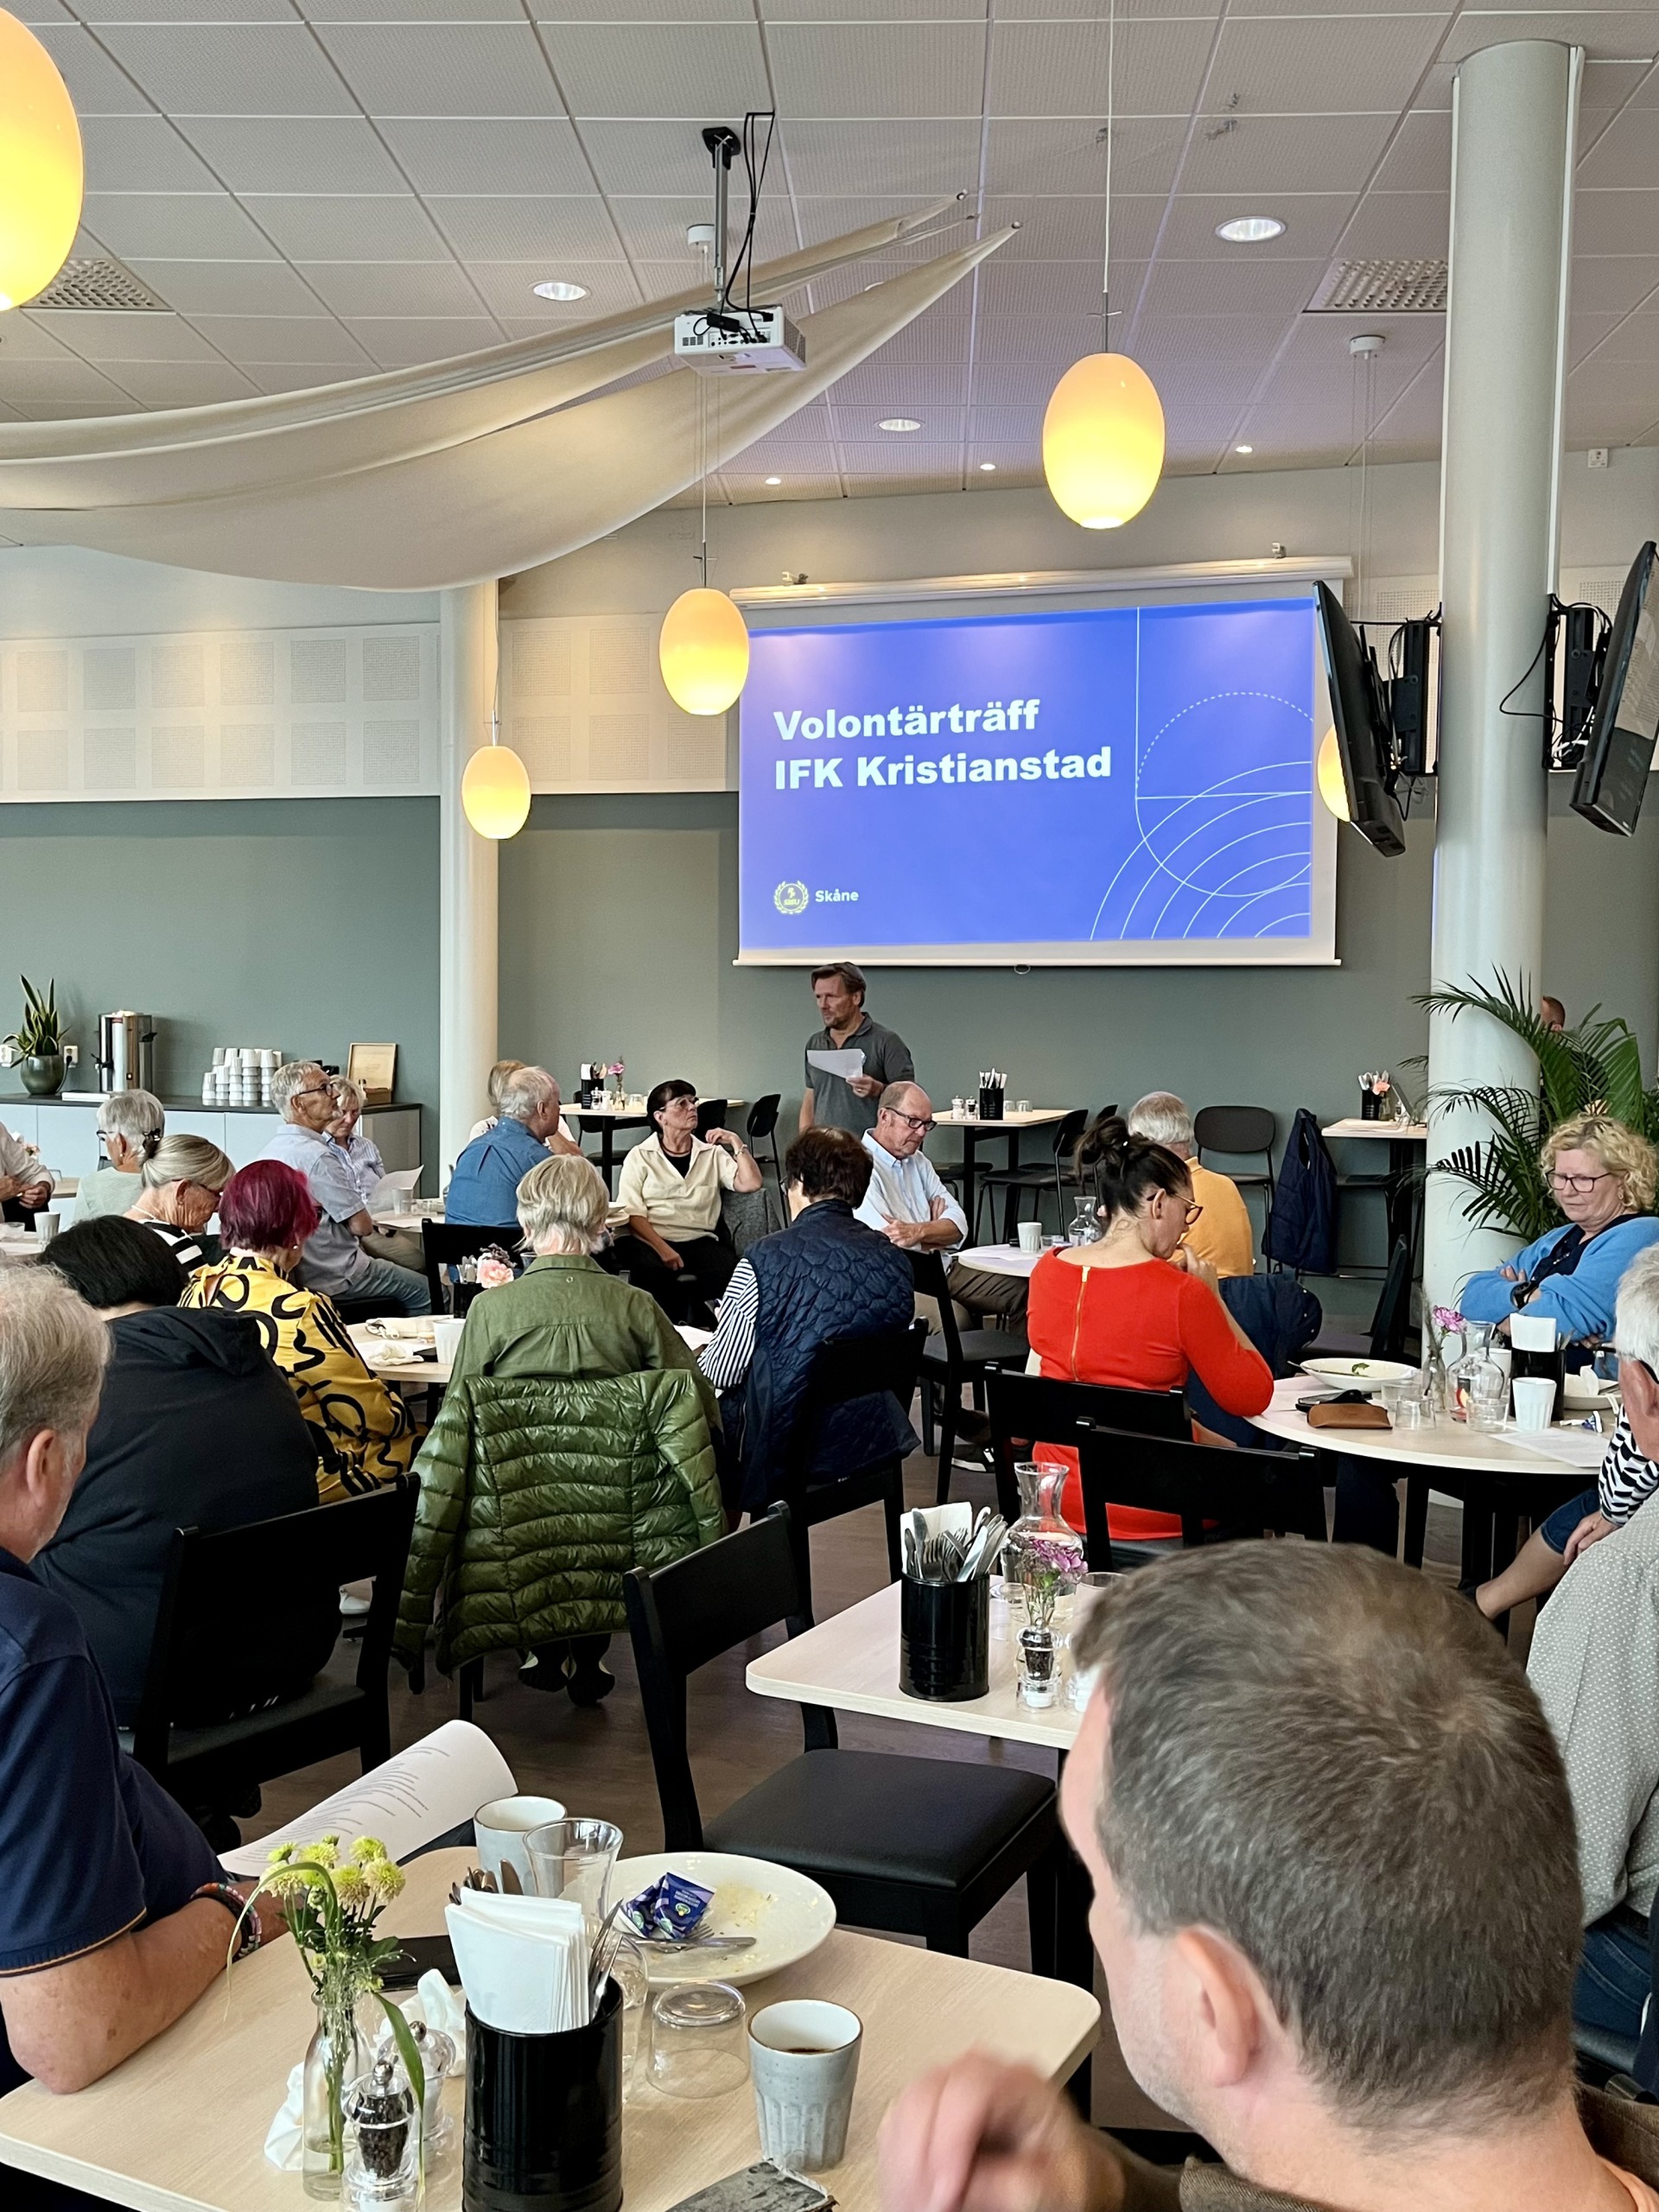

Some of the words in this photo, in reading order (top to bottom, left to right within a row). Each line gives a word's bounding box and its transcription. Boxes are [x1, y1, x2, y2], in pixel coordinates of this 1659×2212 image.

[773, 699, 1040, 741] Volontärträff
[775, 758, 843, 790] IFK
[857, 747, 1111, 787] Kristianstad
[815, 888, 859, 902] Skåne
